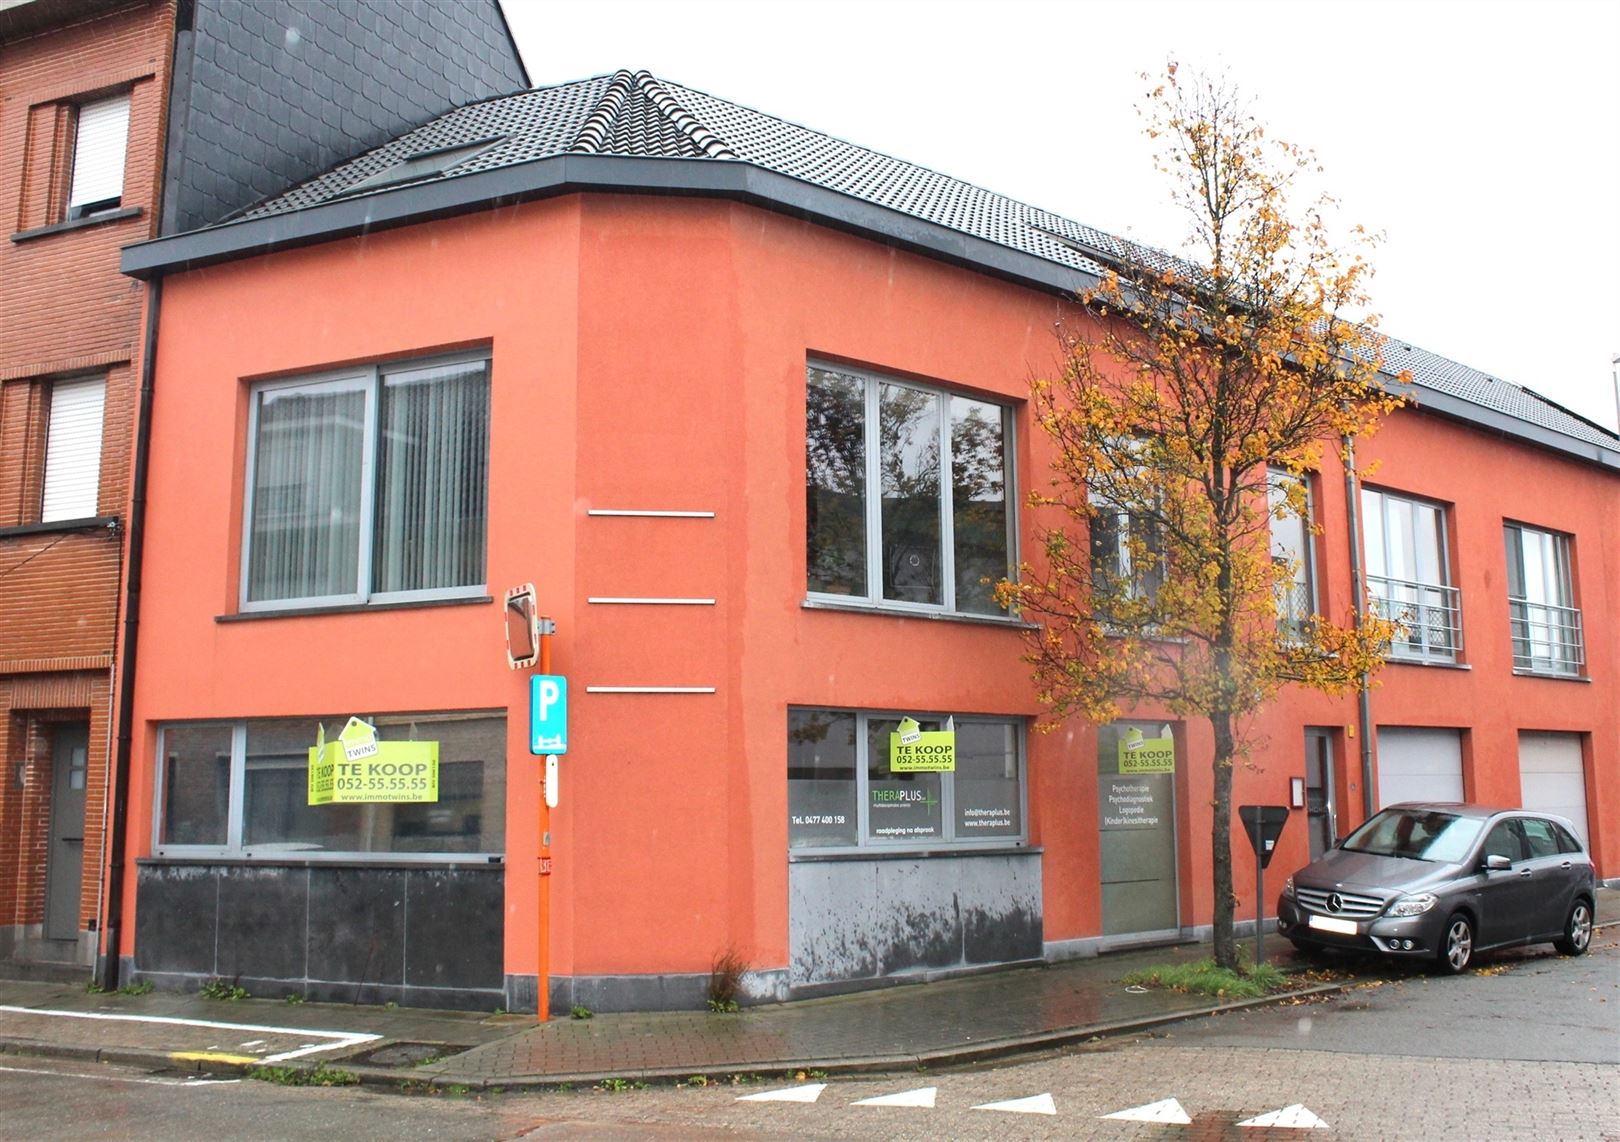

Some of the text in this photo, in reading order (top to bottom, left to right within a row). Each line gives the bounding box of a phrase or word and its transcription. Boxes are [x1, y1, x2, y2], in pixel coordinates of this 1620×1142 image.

[539, 680, 560, 722] P
[347, 744, 377, 758] TWINS
[897, 746, 952, 754] TE KOOP
[896, 755, 952, 764] 052-55.55.55
[1140, 751, 1173, 759] KOOP
[1123, 759, 1173, 768] 052-55.55.55
[337, 764, 362, 776] TE
[368, 763, 428, 776] KOOP
[337, 778, 427, 790] 052-55.55.55
[1112, 784, 1150, 794] Psychotherapie
[341, 793, 423, 801] www.immotwins.be
[872, 790, 922, 801] THERAPLUS
[964, 808, 1011, 818] info@theraplus.be
[1119, 806, 1144, 815] Logopedie
[805, 816, 820, 824] 0477
[821, 816, 833, 824] 400
[834, 816, 845, 824] 158
[964, 819, 1011, 828] www.theraplus.be
